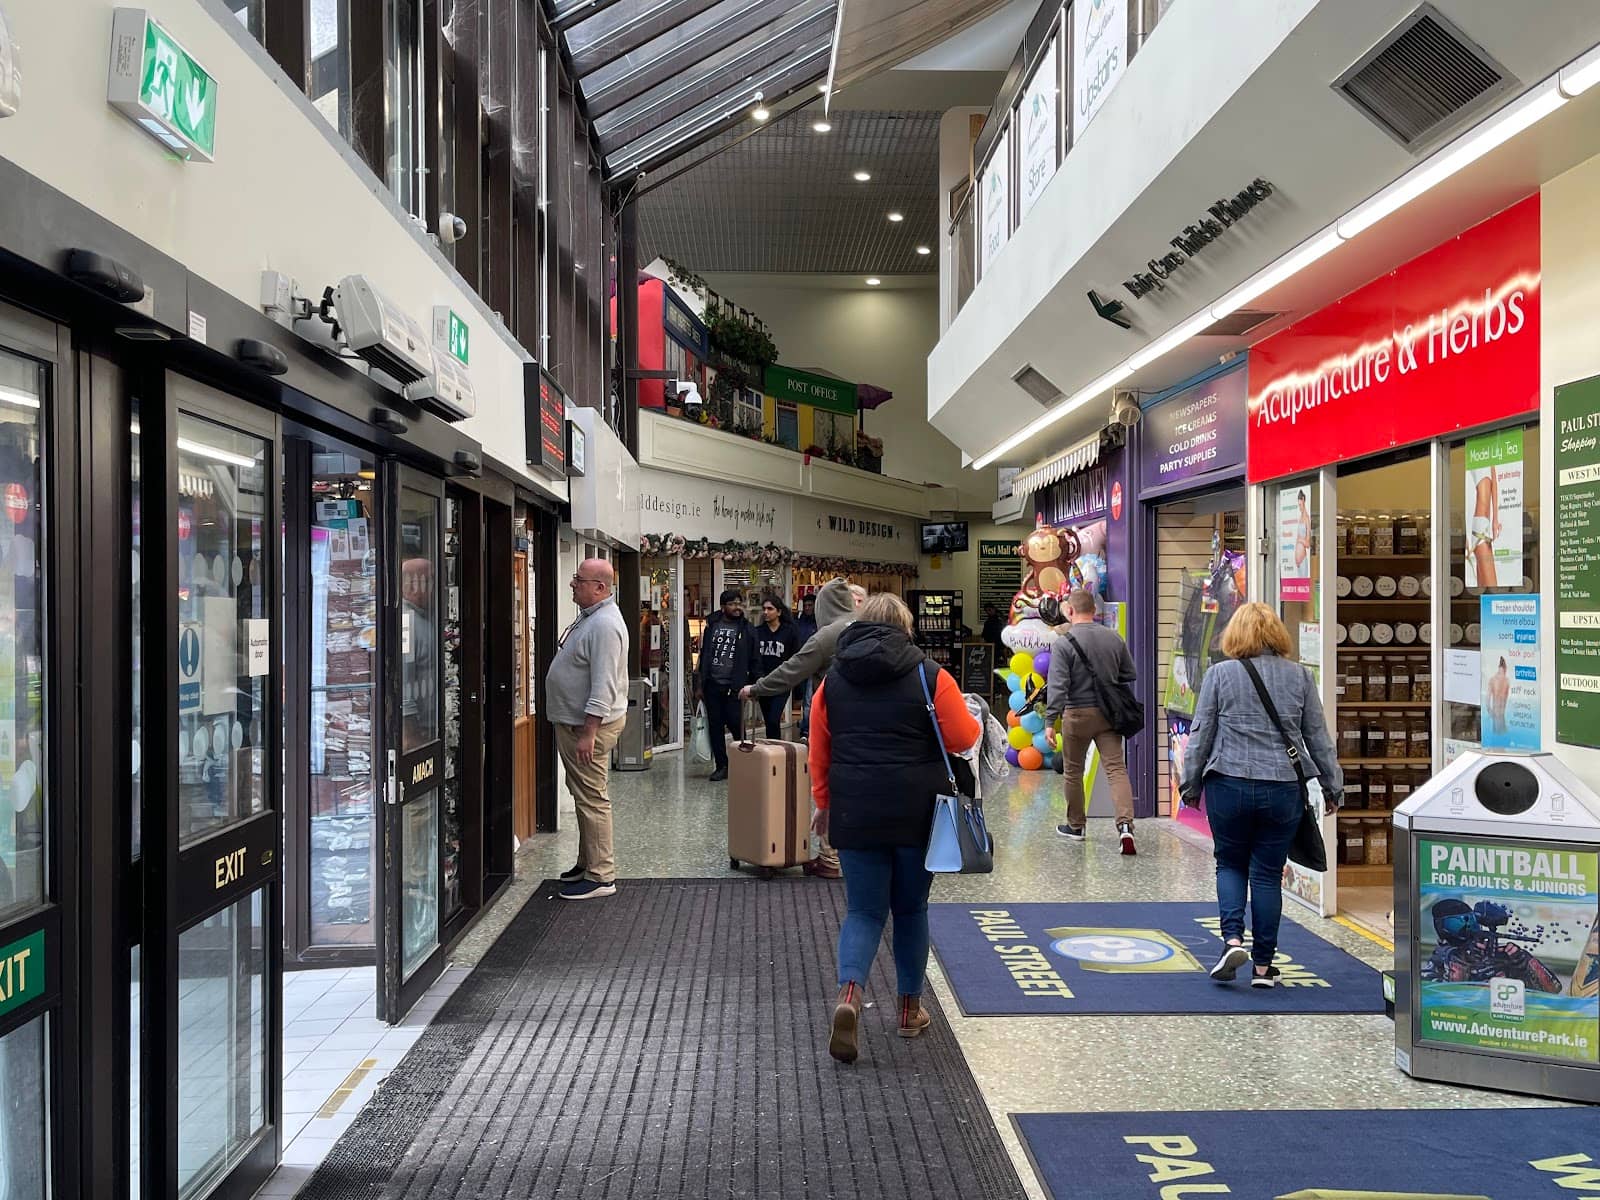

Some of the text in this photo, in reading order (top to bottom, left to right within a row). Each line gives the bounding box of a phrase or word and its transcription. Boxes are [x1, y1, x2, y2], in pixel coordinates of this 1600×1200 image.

[1081, 46, 1118, 121] Upstairs
[1028, 158, 1046, 197] Store
[1208, 177, 1273, 229] Phones
[1256, 288, 1525, 428] Acupuncture & Herbs
[787, 378, 838, 400] POST OFFICE
[1169, 393, 1217, 419] NEWSPAPERS
[1175, 411, 1217, 436] ICE CREAMS
[1560, 417, 1586, 434] PAUL
[1169, 429, 1217, 454] COLD DRINKS
[1470, 447, 1489, 463] Model
[1505, 441, 1518, 455] Tea
[1560, 437, 1597, 453] Shopping
[1160, 447, 1217, 473] PARTY SUPPLIES
[1568, 469, 1590, 481] WEST
[828, 515, 894, 538] WILD DESIGN
[982, 544, 1011, 555] West Mall
[1512, 601, 1535, 612] shoulder
[1502, 617, 1536, 625] tennis elbow
[1009, 636, 1051, 653] Birthday
[1498, 632, 1536, 642] sports injuries
[759, 640, 785, 658] GAP
[1508, 649, 1521, 657] back
[1523, 687, 1536, 696] neck
[1562, 677, 1599, 689] OUTDOOR
[216, 847, 246, 889] EXIT
[1431, 845, 1585, 880] PAINTBALL
[1431, 872, 1586, 896] FOR ADULTS & JUNIORS
[969, 910, 1075, 998] PAUL STREET
[1492, 1001, 1523, 1010] adventure
[1431, 1020, 1588, 1048] www.AdventurePark.ie
